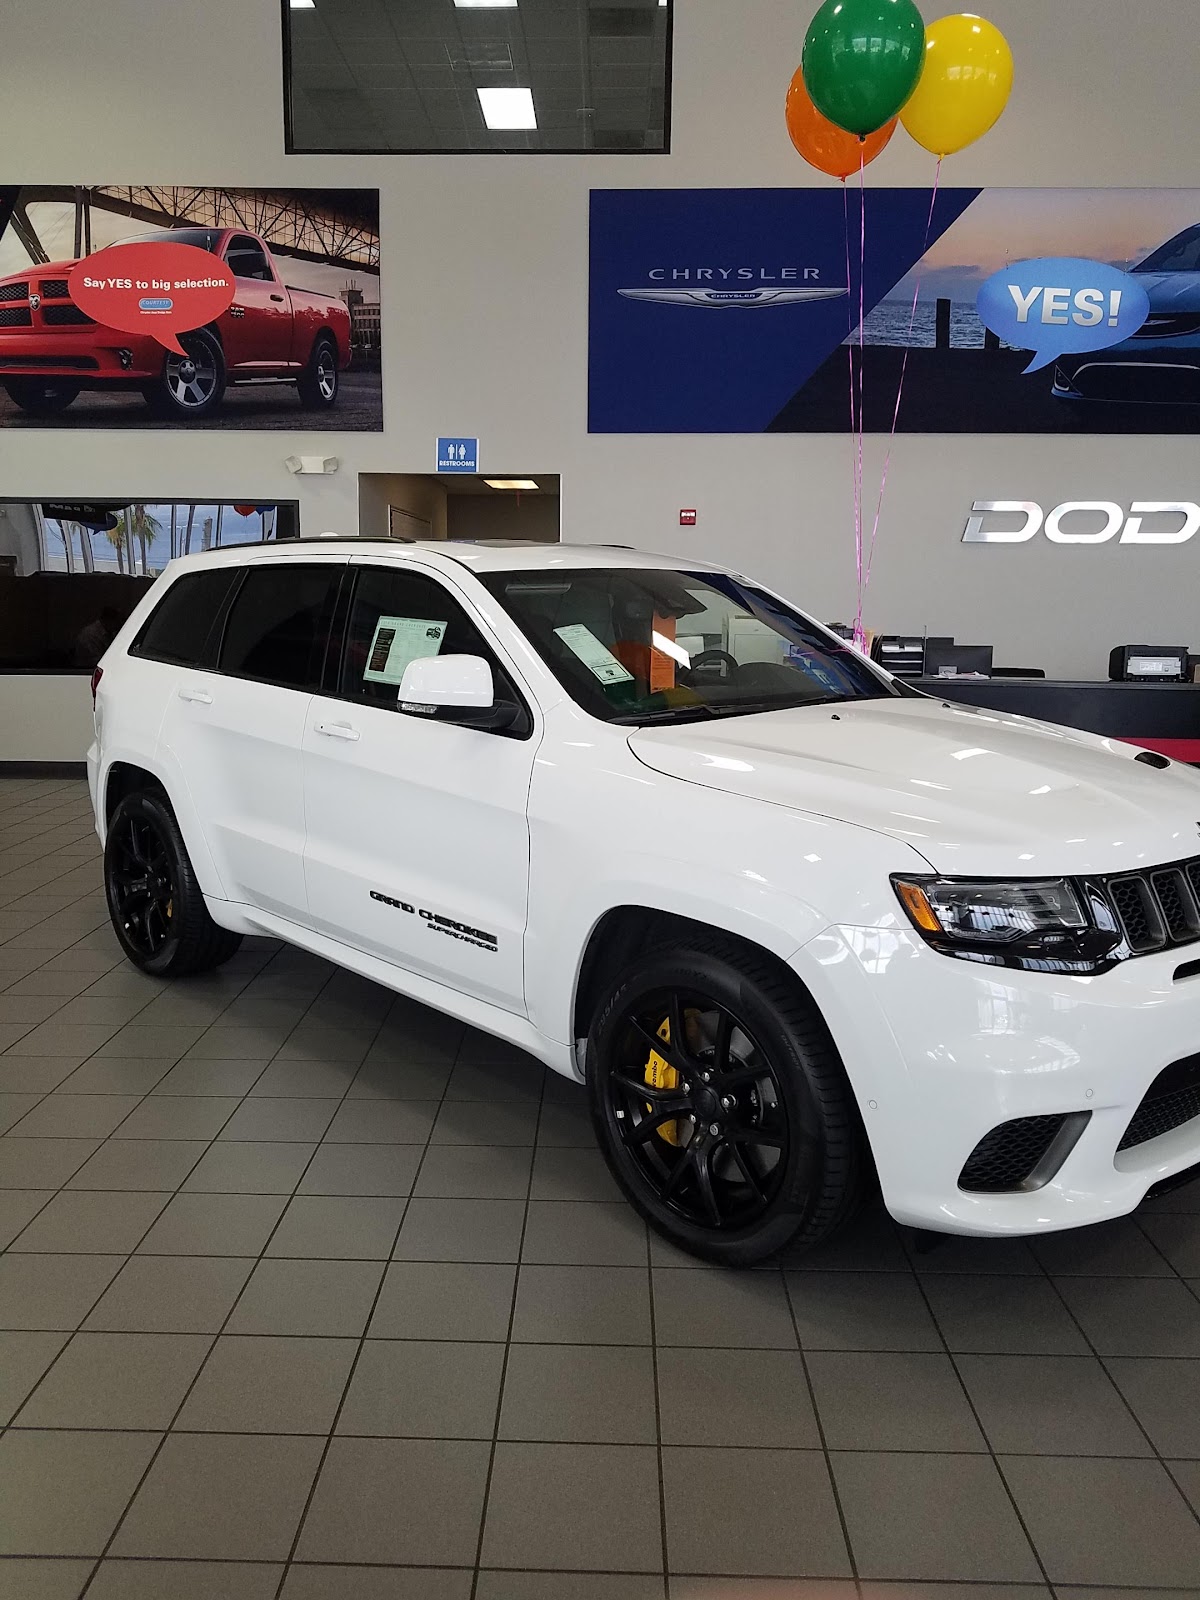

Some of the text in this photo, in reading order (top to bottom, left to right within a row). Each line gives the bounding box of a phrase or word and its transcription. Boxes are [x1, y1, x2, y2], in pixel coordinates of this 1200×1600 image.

[83, 277, 229, 291] Say YES to big selection.
[648, 267, 821, 280] CHRYSLER
[1007, 284, 1122, 327] YES!
[961, 500, 1200, 544] DOD
[369, 890, 497, 945] GRAND CHEROKEE
[426, 922, 498, 952] SUPERCHARGED
